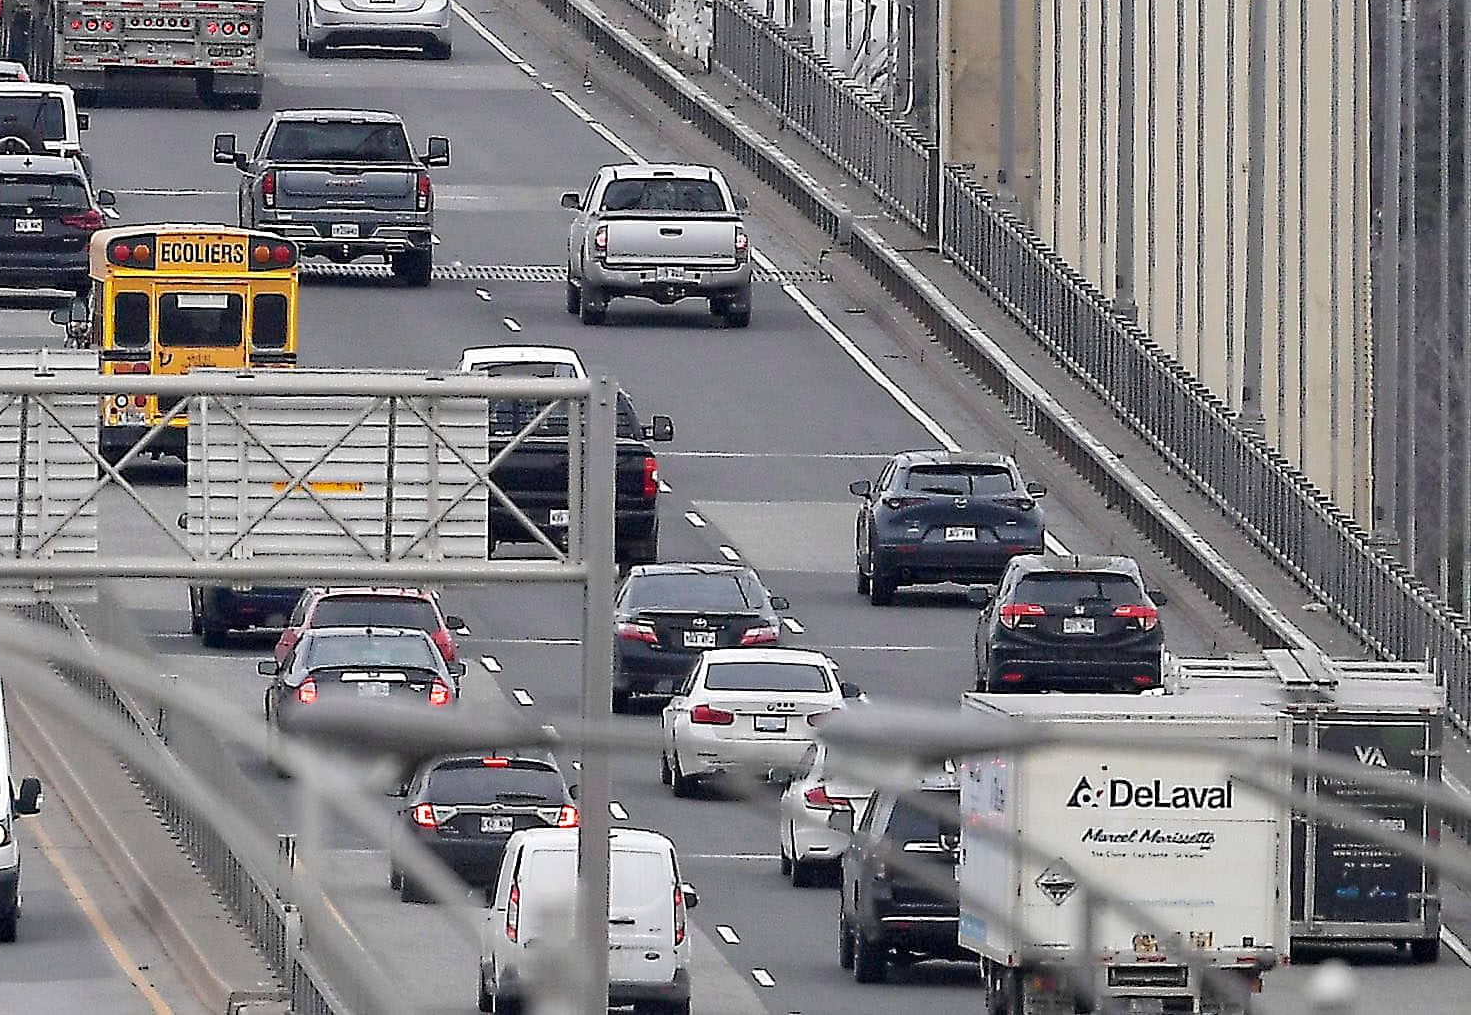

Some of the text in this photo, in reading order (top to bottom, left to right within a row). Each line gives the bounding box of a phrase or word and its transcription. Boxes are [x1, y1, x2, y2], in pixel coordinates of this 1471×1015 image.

[161, 243, 244, 263] ECOLIERS
[1110, 779, 1232, 809] DeLaval
[1081, 828, 1138, 843] Marcel
